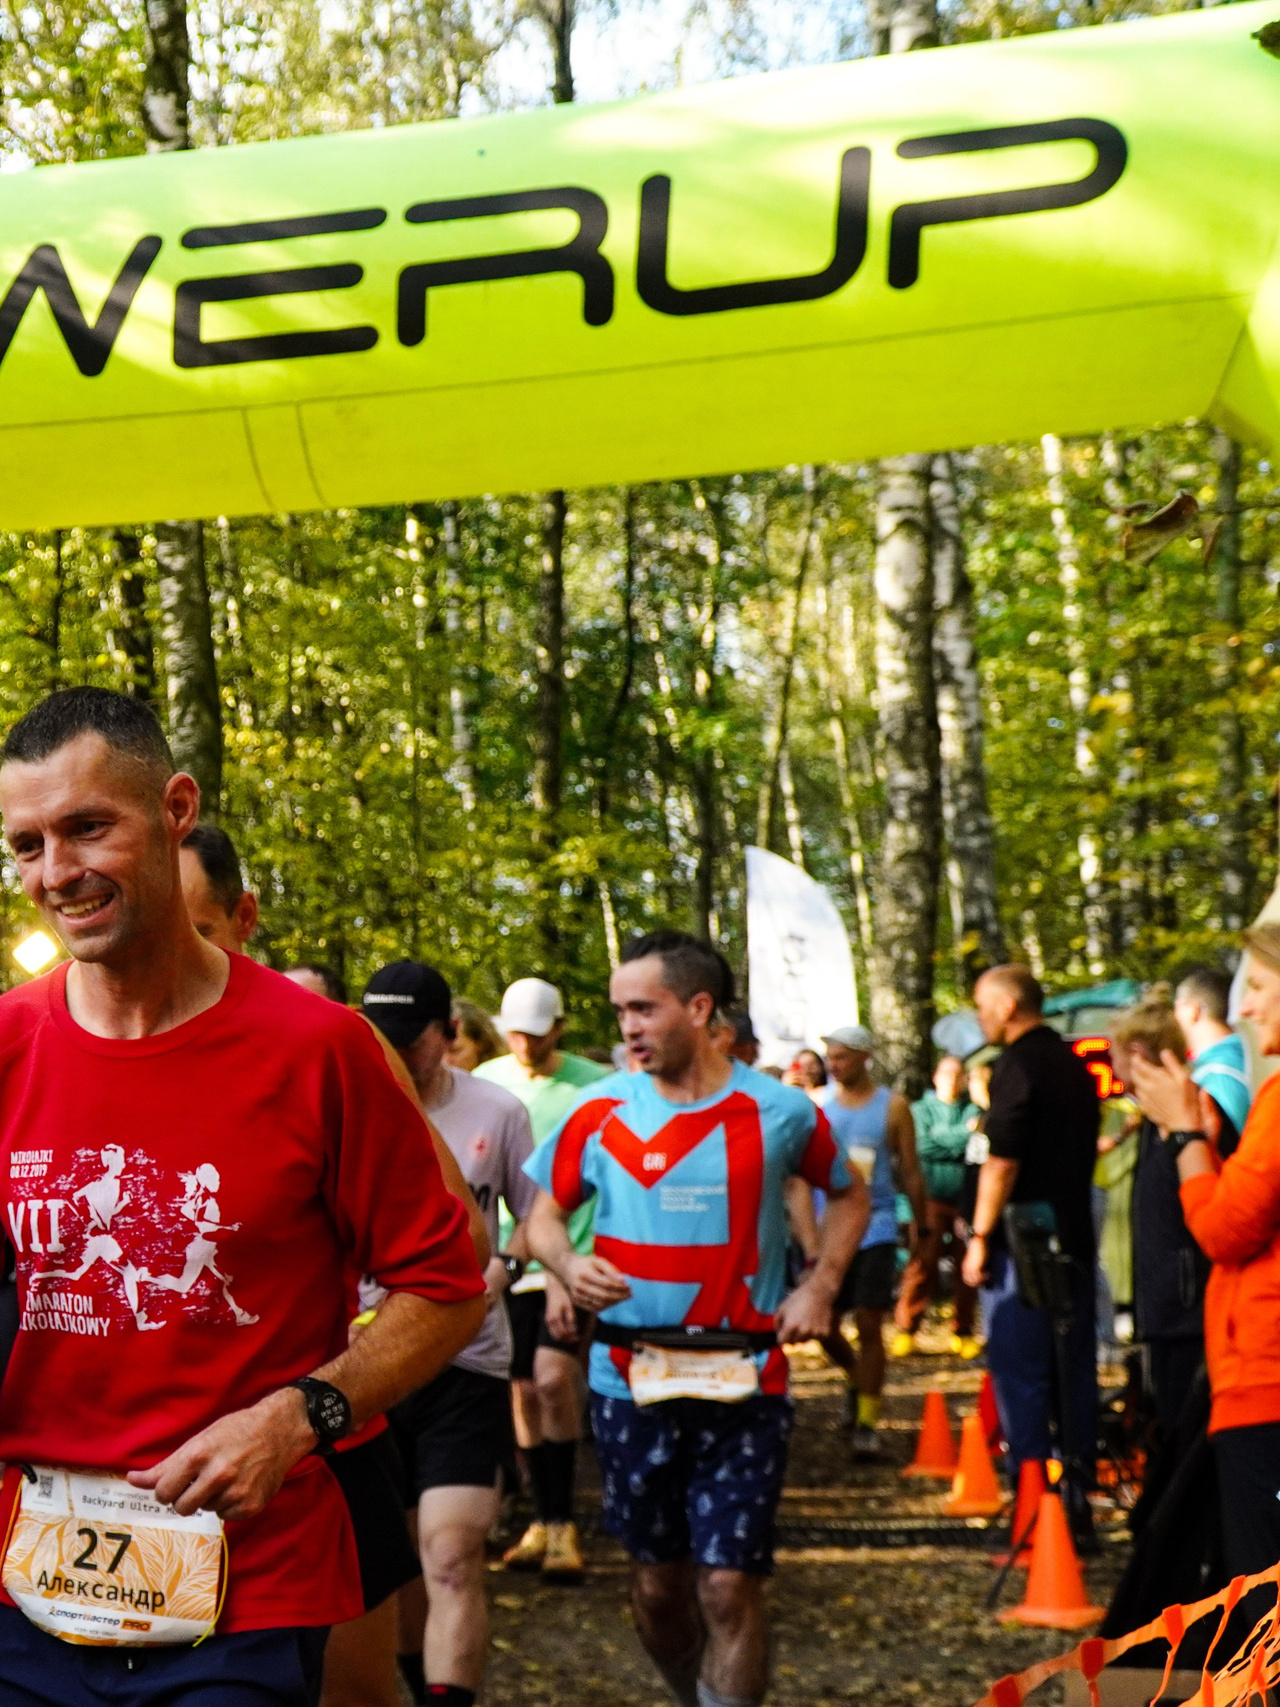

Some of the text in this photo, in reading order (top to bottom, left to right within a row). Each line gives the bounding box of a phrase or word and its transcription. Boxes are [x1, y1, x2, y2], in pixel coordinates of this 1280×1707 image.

[7, 1199, 67, 1254] VII
[19, 1311, 111, 1338] IKOŁAJKOWY
[82, 1495, 125, 1510] Backyard
[130, 1502, 160, 1513] Ultra
[73, 1527, 132, 1574] 27
[37, 1570, 166, 1613] Александр
[123, 1620, 150, 1632] PRO
